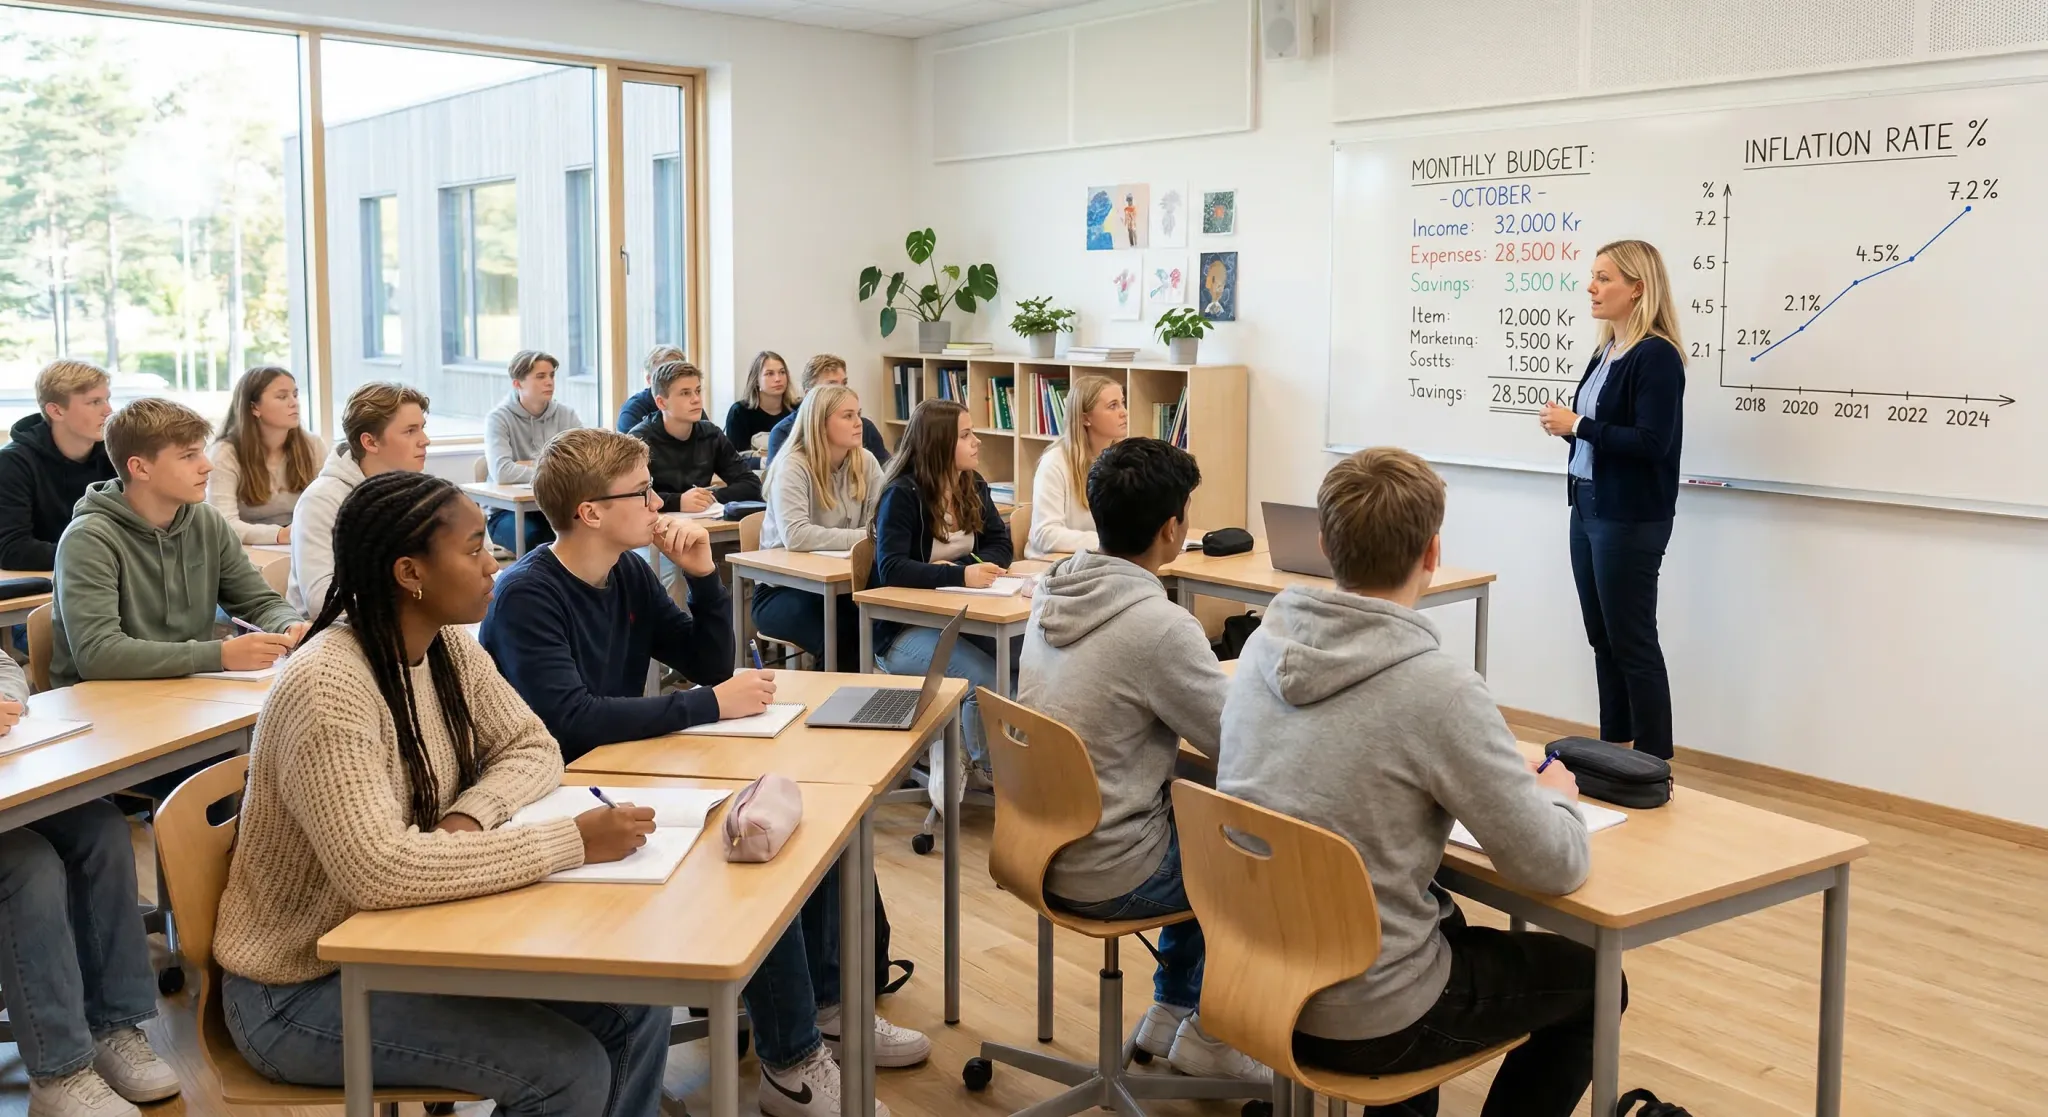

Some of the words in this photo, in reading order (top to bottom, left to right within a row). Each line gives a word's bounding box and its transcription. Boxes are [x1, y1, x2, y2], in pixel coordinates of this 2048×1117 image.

[1744, 129, 1872, 165] INFLATION
[1885, 122, 1954, 154] RATE
[1965, 117, 1989, 150] %
[1411, 151, 1497, 181] MONTHLY
[1507, 144, 1596, 174] BUDGET:
[1452, 183, 1532, 209] OCTOBER
[1701, 181, 1715, 199] %
[1947, 178, 1999, 201] 7.2%
[1412, 218, 1475, 238] Income:
[1494, 212, 1556, 236] 32,000
[1562, 211, 1582, 232] Kr
[1694, 210, 1717, 227] 7.2
[1411, 244, 1488, 270] Expenses:
[1494, 242, 1556, 265] 28,500
[1561, 241, 1581, 262] Kr
[1692, 255, 1716, 271] 6.5
[1855, 243, 1900, 264] 4.5%
[1410, 272, 1475, 300] Savings:
[1504, 271, 1554, 294] 3,500
[1559, 272, 1580, 293] Kr
[1691, 298, 1715, 315] 4.5
[1783, 294, 1822, 313] 2.1%
[1412, 305, 1451, 324] Item:
[1498, 307, 1551, 328] 12,000
[1556, 308, 1576, 328] Kr
[1556, 332, 1575, 352] Kr
[1736, 328, 1772, 347] 2.1%
[1690, 341, 1711, 359] 2.1
[1556, 356, 1575, 375] Kr
[1555, 387, 1576, 408] Kr
[1734, 396, 1767, 413] 2018
[1782, 399, 1819, 417] 2020
[1833, 402, 1870, 420] 2021
[1887, 406, 1928, 424] 2022
[1945, 408, 1991, 428] 2024
